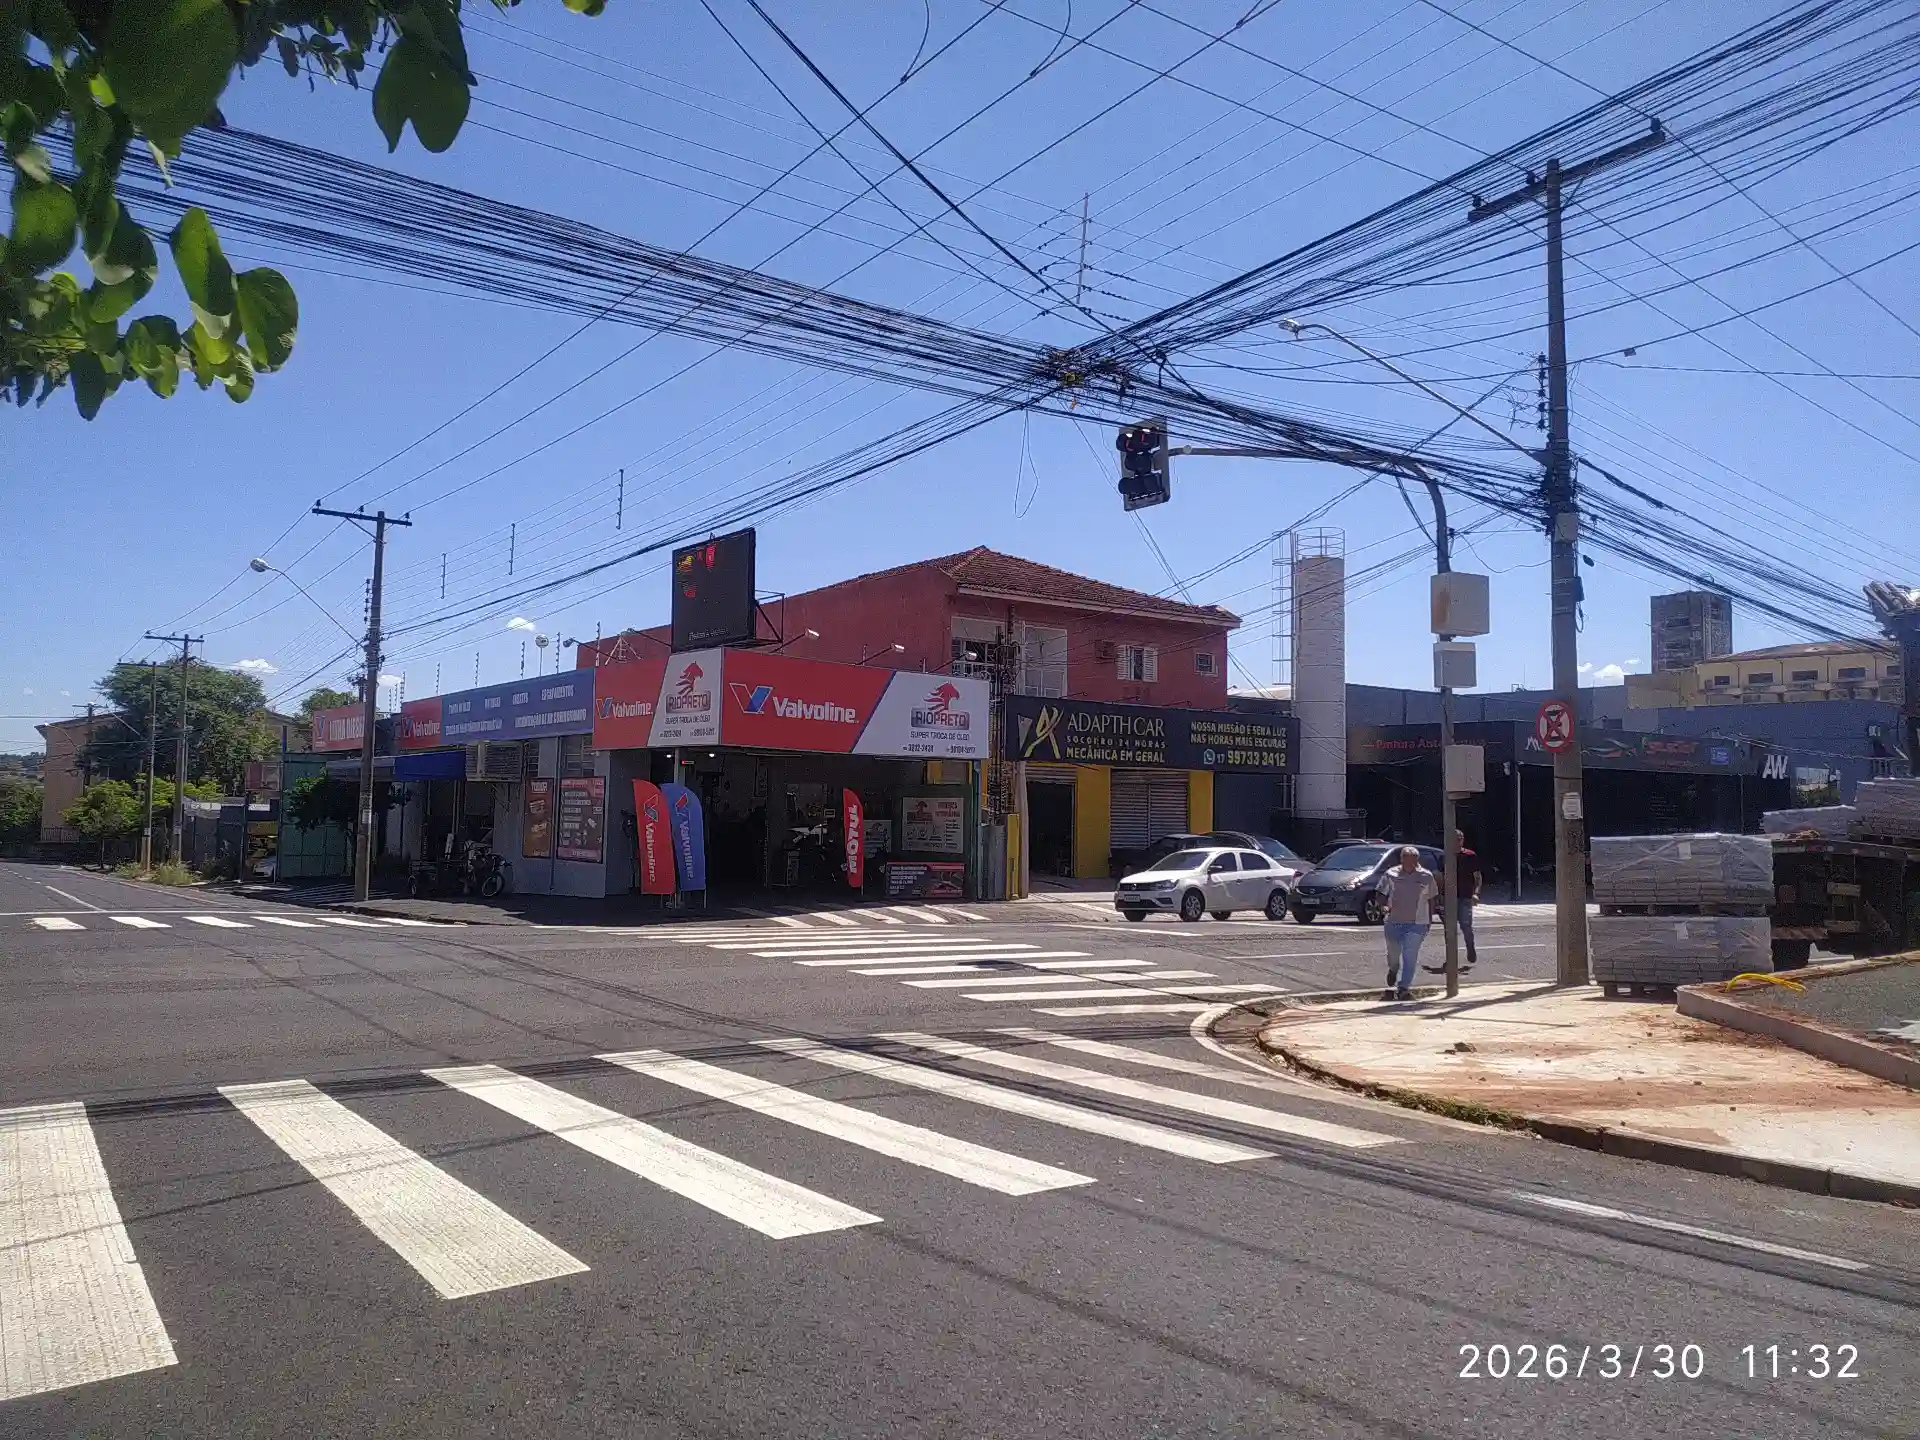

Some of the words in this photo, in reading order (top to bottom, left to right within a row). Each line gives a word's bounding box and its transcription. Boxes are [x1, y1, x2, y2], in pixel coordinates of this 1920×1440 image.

[612, 700, 652, 719] Valvoline
[772, 696, 857, 724] Valvoline
[413, 719, 440, 737] Valvoline
[1067, 712, 1131, 735] ADAPTH
[1133, 716, 1165, 737] CAR
[1190, 722, 1217, 733] NOSSA
[1218, 722, 1246, 734] MISSÃO
[1272, 727, 1287, 738] LUZ
[910, 731, 929, 739] SUPER
[931, 732, 948, 740] TROCA
[1066, 735, 1113, 746] SOCORRO
[1119, 738, 1129, 747] 24
[1134, 739, 1166, 749] HORAS
[1190, 733, 1207, 744] NAS
[1208, 734, 1234, 746] HORAS
[1235, 736, 1253, 747] MAIS
[1254, 737, 1287, 749] ESCURAS
[1376, 739, 1416, 749] Pintura
[1066, 745, 1117, 761] MECÂNICA
[1120, 750, 1133, 761] EM
[1135, 751, 1165, 763] GERAL
[1216, 753, 1225, 764] 17
[1227, 750, 1260, 766] 99733
[1261, 751, 1287, 767] 3412
[846, 804, 859, 874] MOTUL
[645, 822, 657, 883] Valvoline
[679, 820, 694, 880] Valvoline
